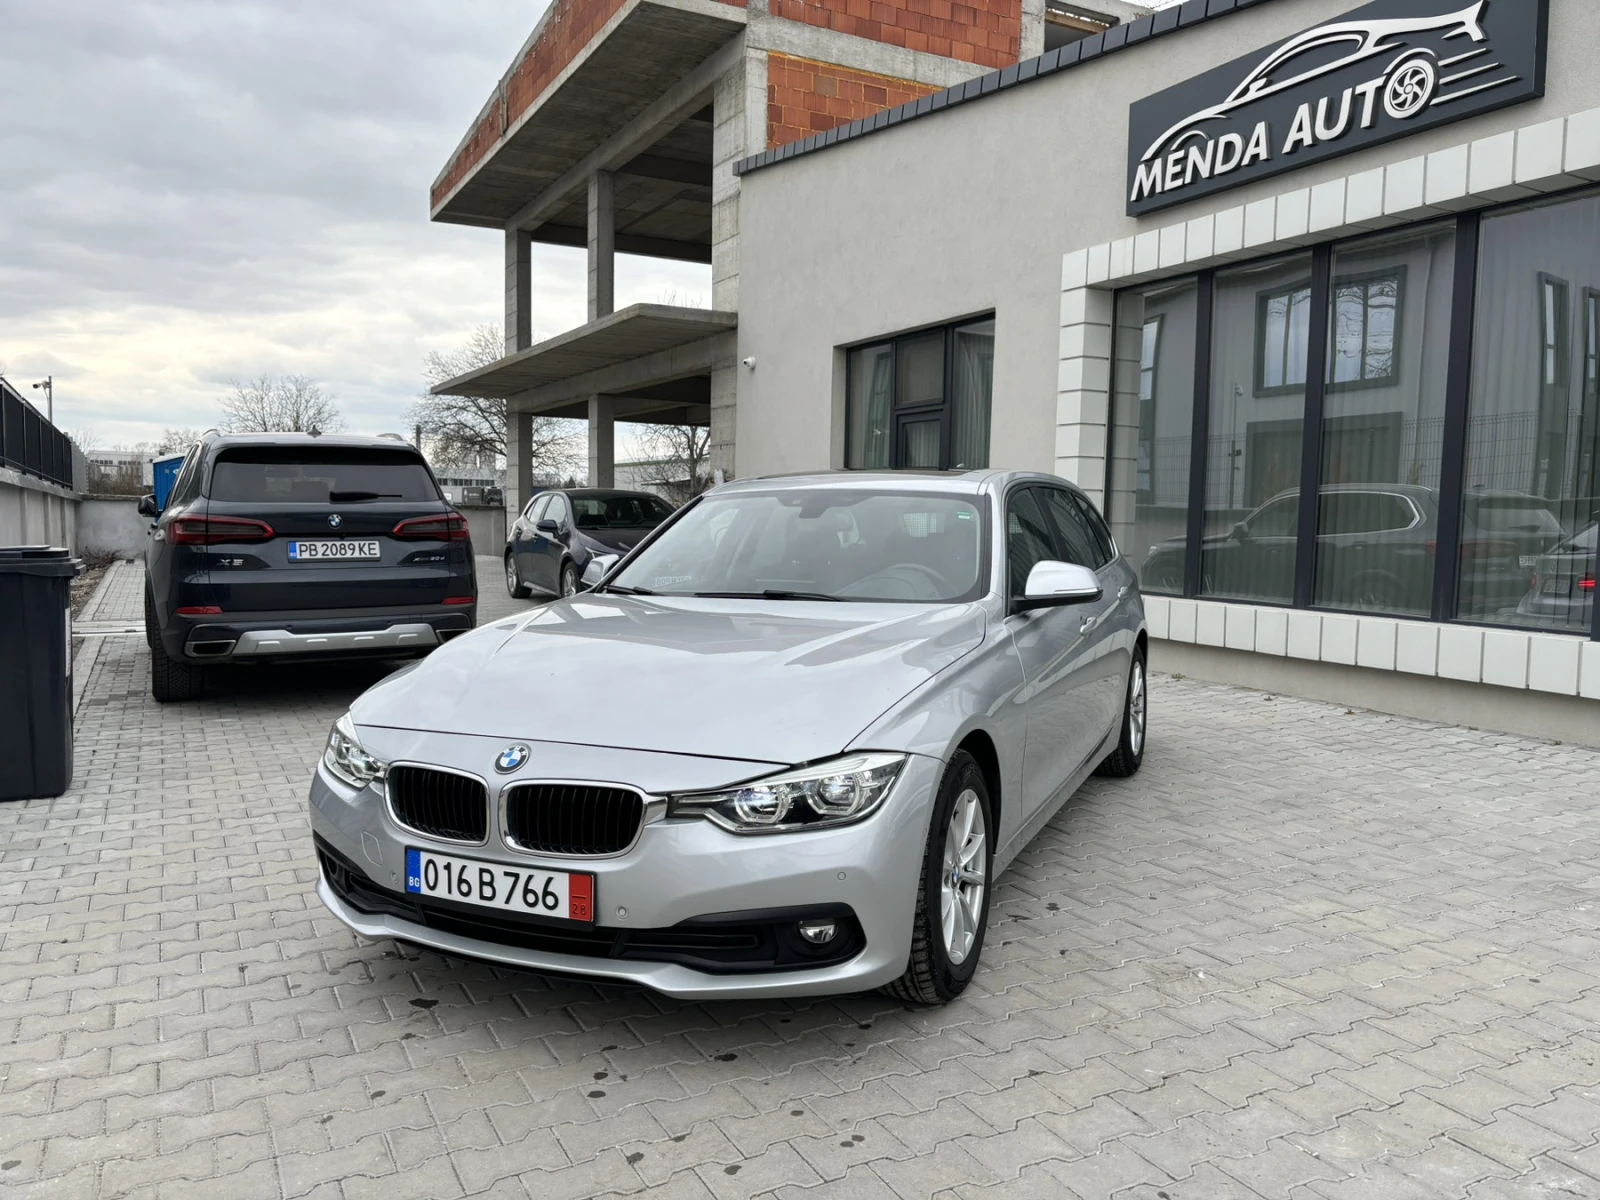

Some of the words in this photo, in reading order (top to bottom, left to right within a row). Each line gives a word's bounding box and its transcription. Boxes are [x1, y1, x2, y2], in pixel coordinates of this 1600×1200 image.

[1130, 121, 1269, 201] MENDA
[299, 543, 318, 557] PB
[321, 542, 356, 557] 2089
[358, 542, 378, 556] KE
[409, 876, 420, 888] BG
[572, 903, 587, 916] 28
